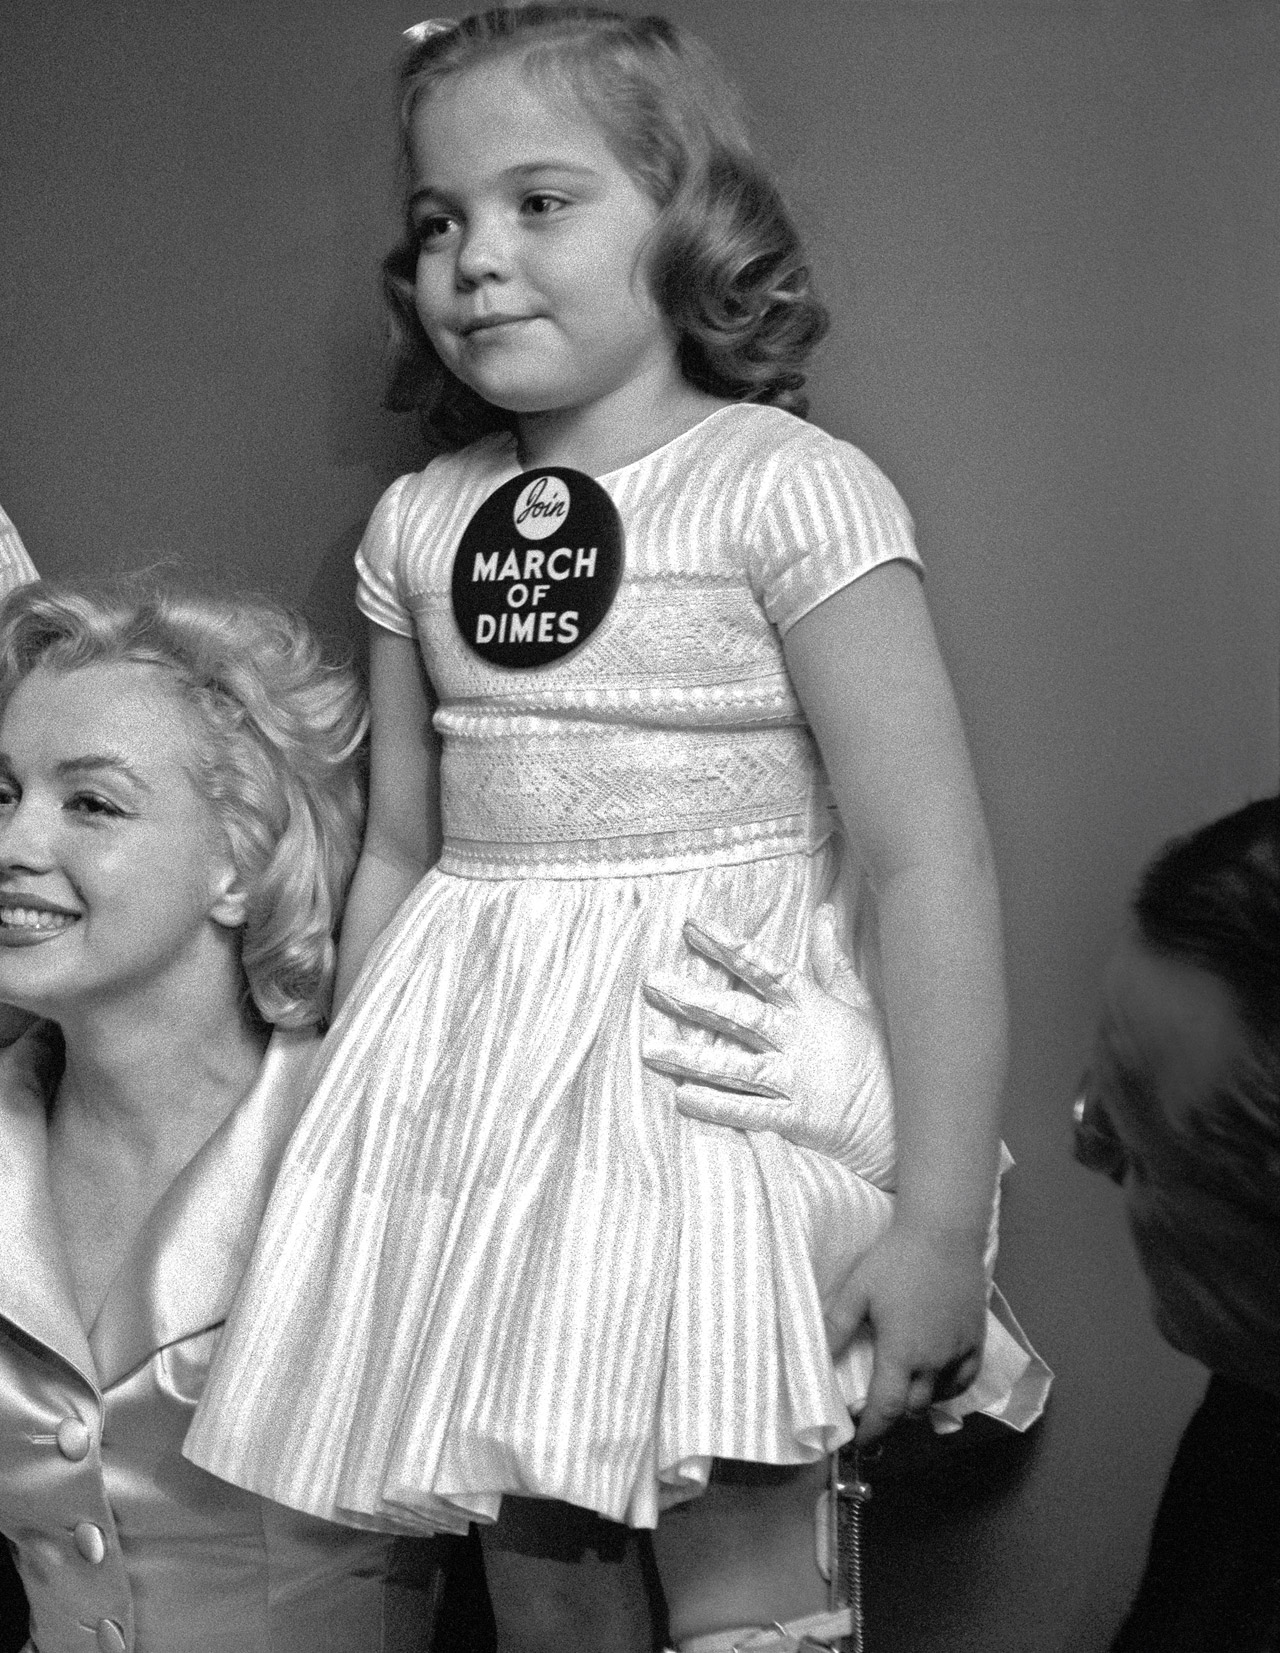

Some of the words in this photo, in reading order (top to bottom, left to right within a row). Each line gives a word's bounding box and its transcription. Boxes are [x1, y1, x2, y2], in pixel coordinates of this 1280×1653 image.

[517, 477, 566, 524] Join
[472, 547, 598, 582] MARCH
[506, 583, 551, 608] OF
[476, 610, 580, 644] DIMES
